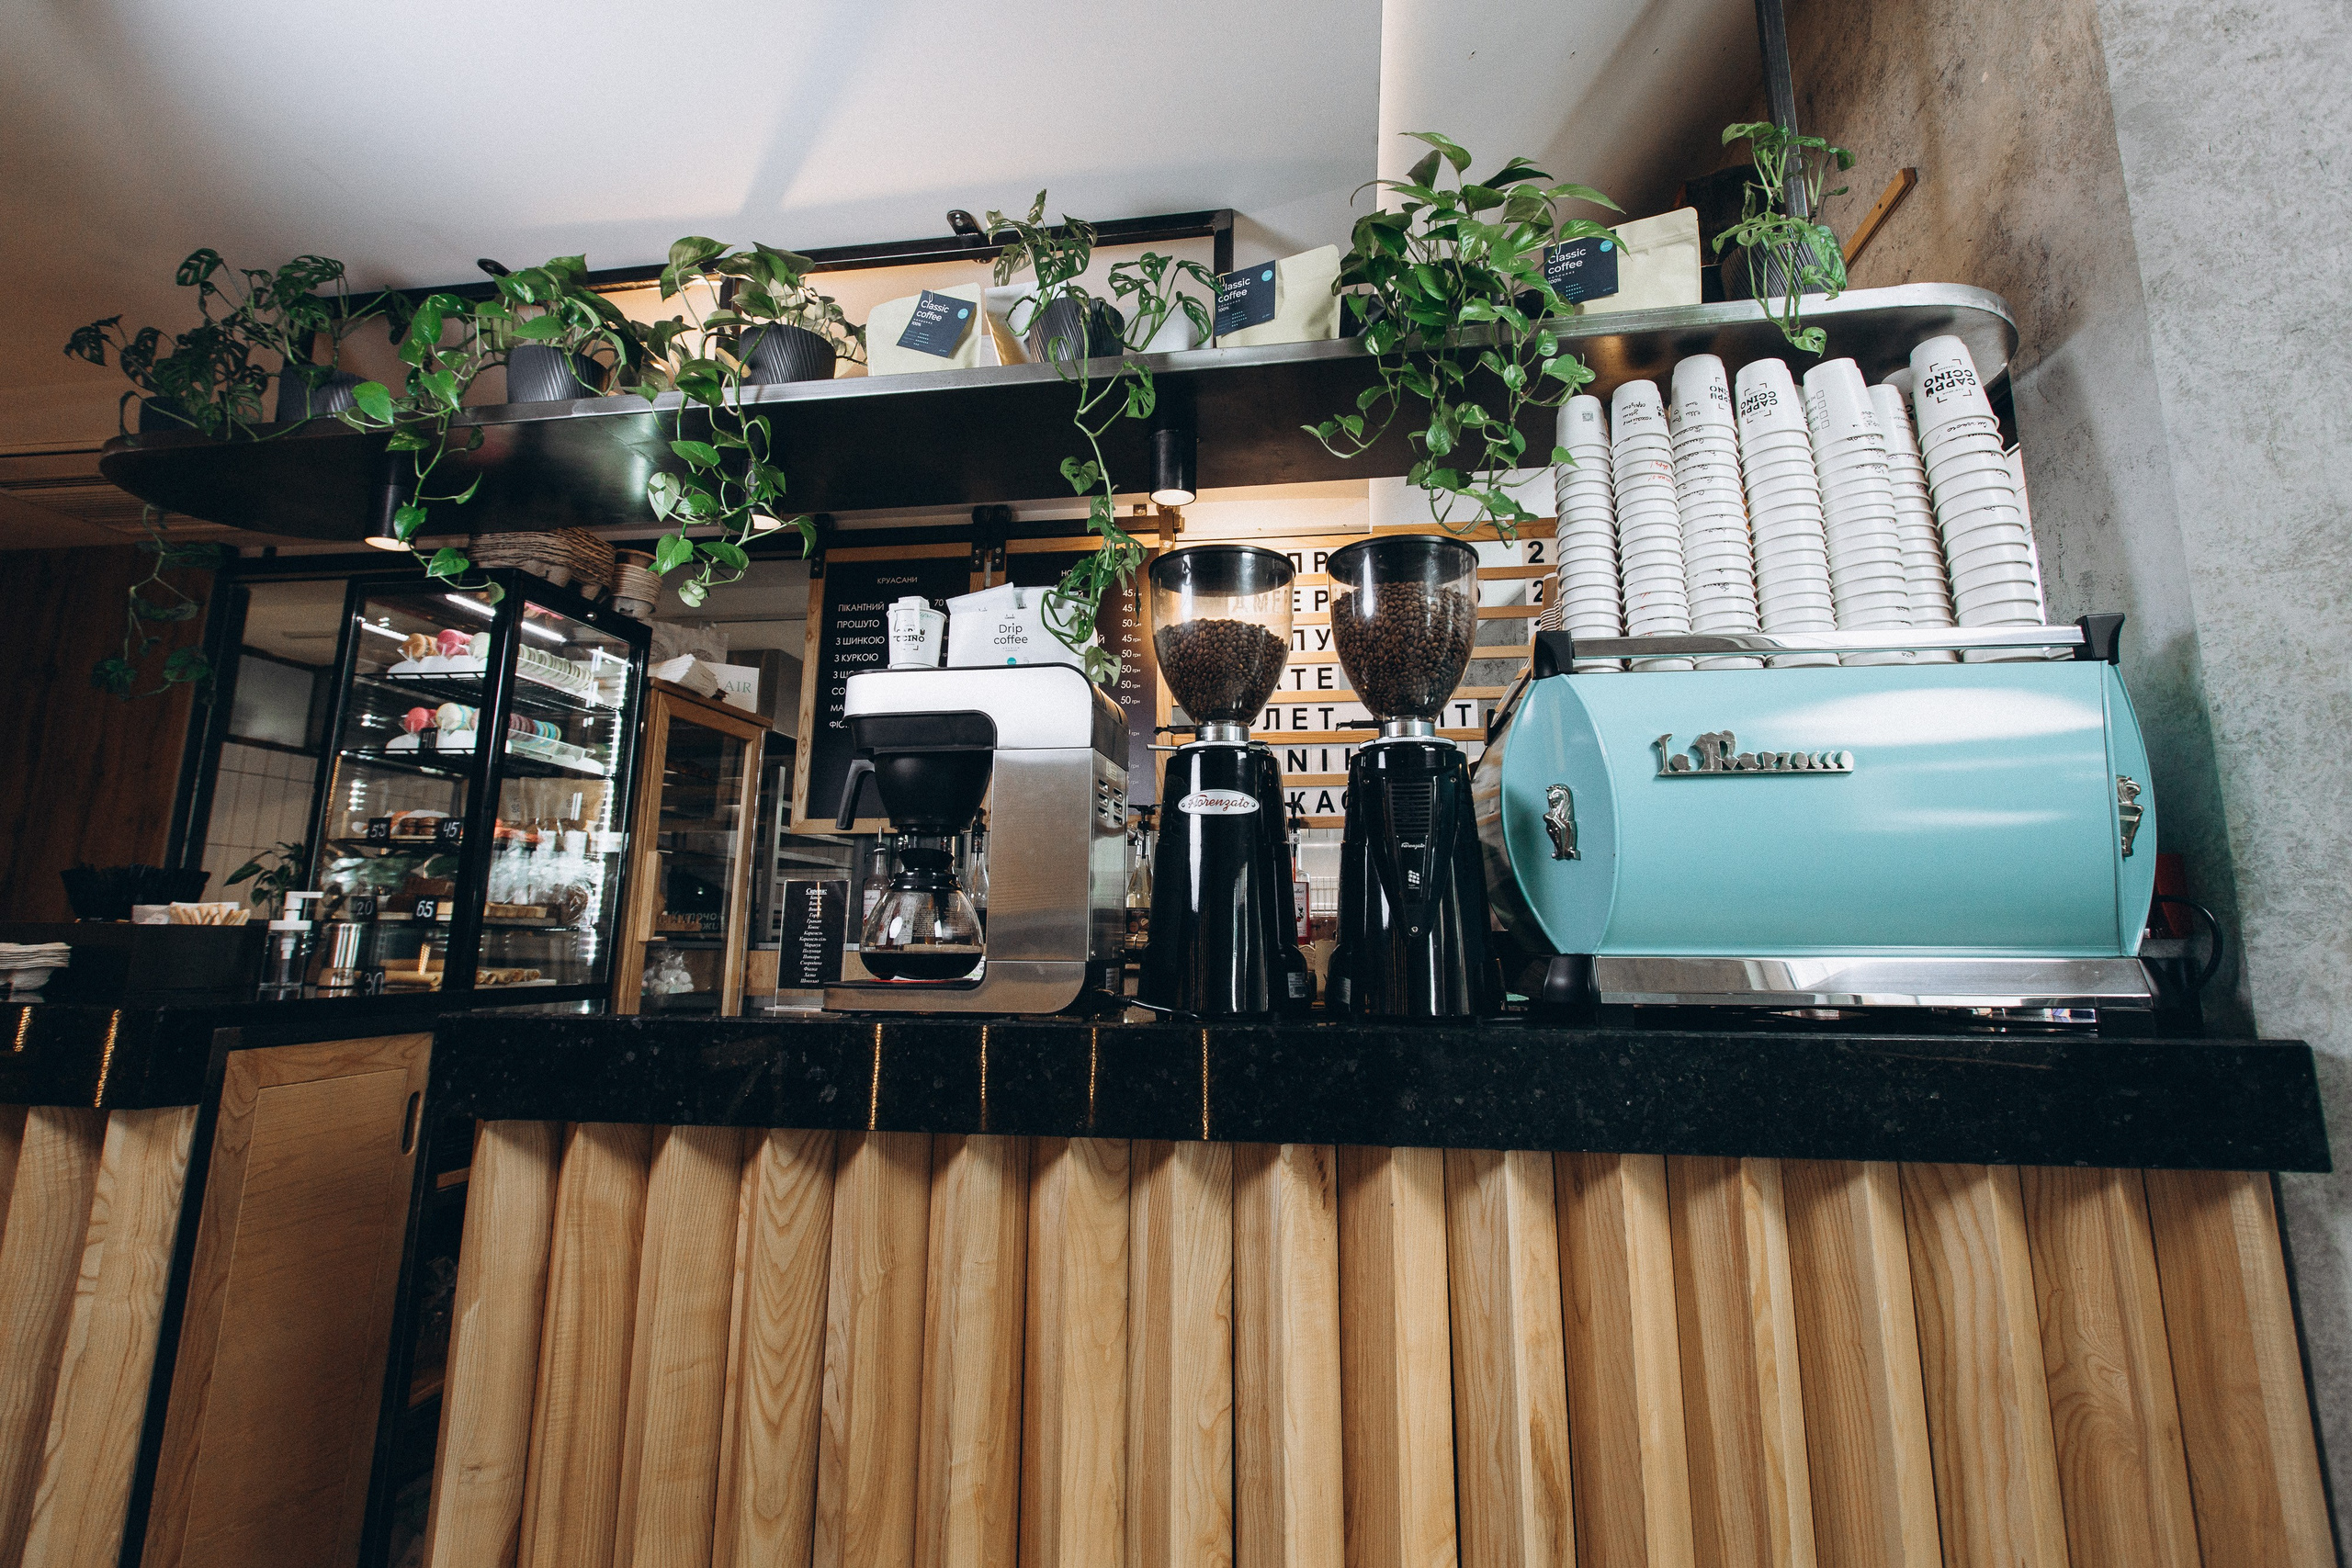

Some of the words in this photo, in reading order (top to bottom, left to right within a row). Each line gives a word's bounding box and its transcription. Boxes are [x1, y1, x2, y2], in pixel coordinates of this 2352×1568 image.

[1547, 248, 1587, 265] Classic
[1547, 260, 1583, 275] coffee
[1217, 288, 1248, 303] coffee
[921, 299, 950, 313] Classic
[916, 310, 943, 321] coffee
[1923, 369, 1973, 388] CCINO
[1925, 378, 1976, 398] CAPPU
[1740, 390, 1777, 410] CCINO
[1740, 398, 1778, 418] CAPPU
[1527, 540, 1544, 564] 2
[876, 576, 918, 584] КРУАСАНИ
[1122, 589, 1133, 597] 45
[838, 601, 885, 612] ПІКАНТНИЙ
[933, 598, 944, 607] 70
[1122, 604, 1133, 613] 45
[836, 619, 880, 629] ПРОШУТО
[999, 622, 1023, 635] Drip
[1122, 619, 1133, 627] 50
[835, 637, 842, 646] З
[842, 636, 886, 646] ШИНКОЮ
[993, 635, 1028, 645] coffee
[1121, 634, 1133, 643] 45
[834, 654, 840, 662] З
[841, 653, 879, 662] КУРКОЮ
[1121, 649, 1132, 658] 50
[832, 671, 839, 679] З
[1121, 664, 1132, 673] 50
[1120, 680, 1131, 689] 50
[1277, 667, 1334, 691] ТЕ
[723, 681, 752, 694] AIR
[1120, 695, 1131, 705] 50
[1250, 707, 1335, 730] ЛЕТ
[1651, 733, 1692, 776] La
[443, 821, 460, 838] 45
[356, 900, 373, 916] 20
[416, 899, 435, 918] 65
